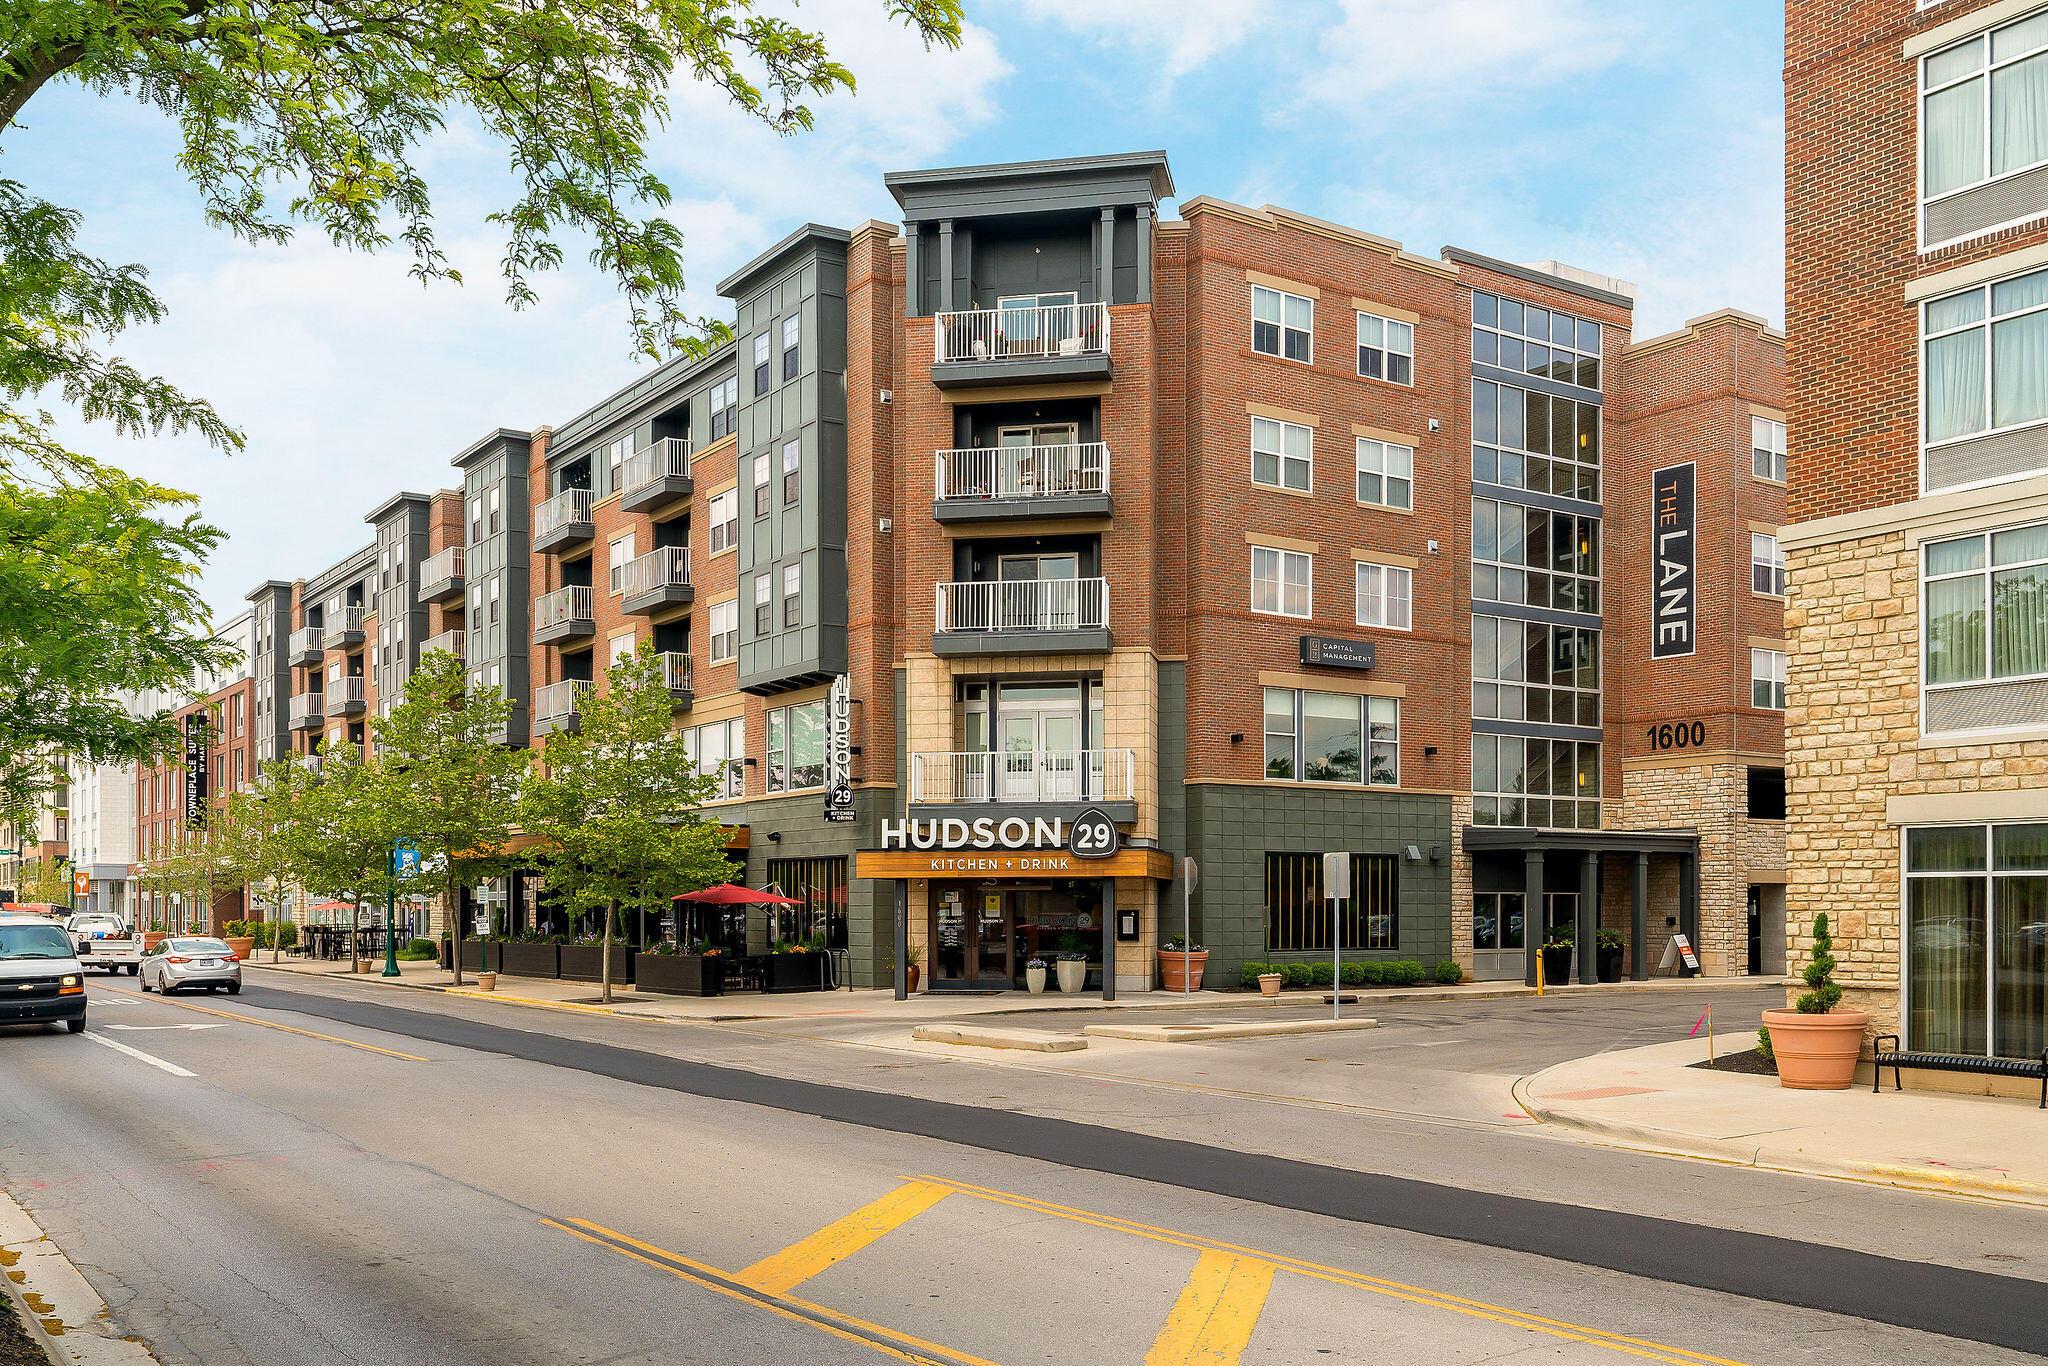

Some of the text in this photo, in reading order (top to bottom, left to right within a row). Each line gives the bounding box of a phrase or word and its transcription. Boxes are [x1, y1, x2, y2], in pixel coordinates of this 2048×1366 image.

[1660, 480, 1677, 528] THE
[1659, 530, 1688, 646] LANE
[1322, 643, 1354, 653] CAPITAL
[1322, 652, 1373, 663] MANAGEMENT
[188, 723, 197, 755] SUES
[835, 687, 851, 780] HUDSON
[1647, 720, 1706, 750] 1600
[199, 763, 206, 773] BY
[834, 789, 852, 803] 29
[880, 816, 1111, 849] HUDSON 29
[931, 858, 999, 870] KITCHEN
[1020, 858, 1070, 870] DRINK
